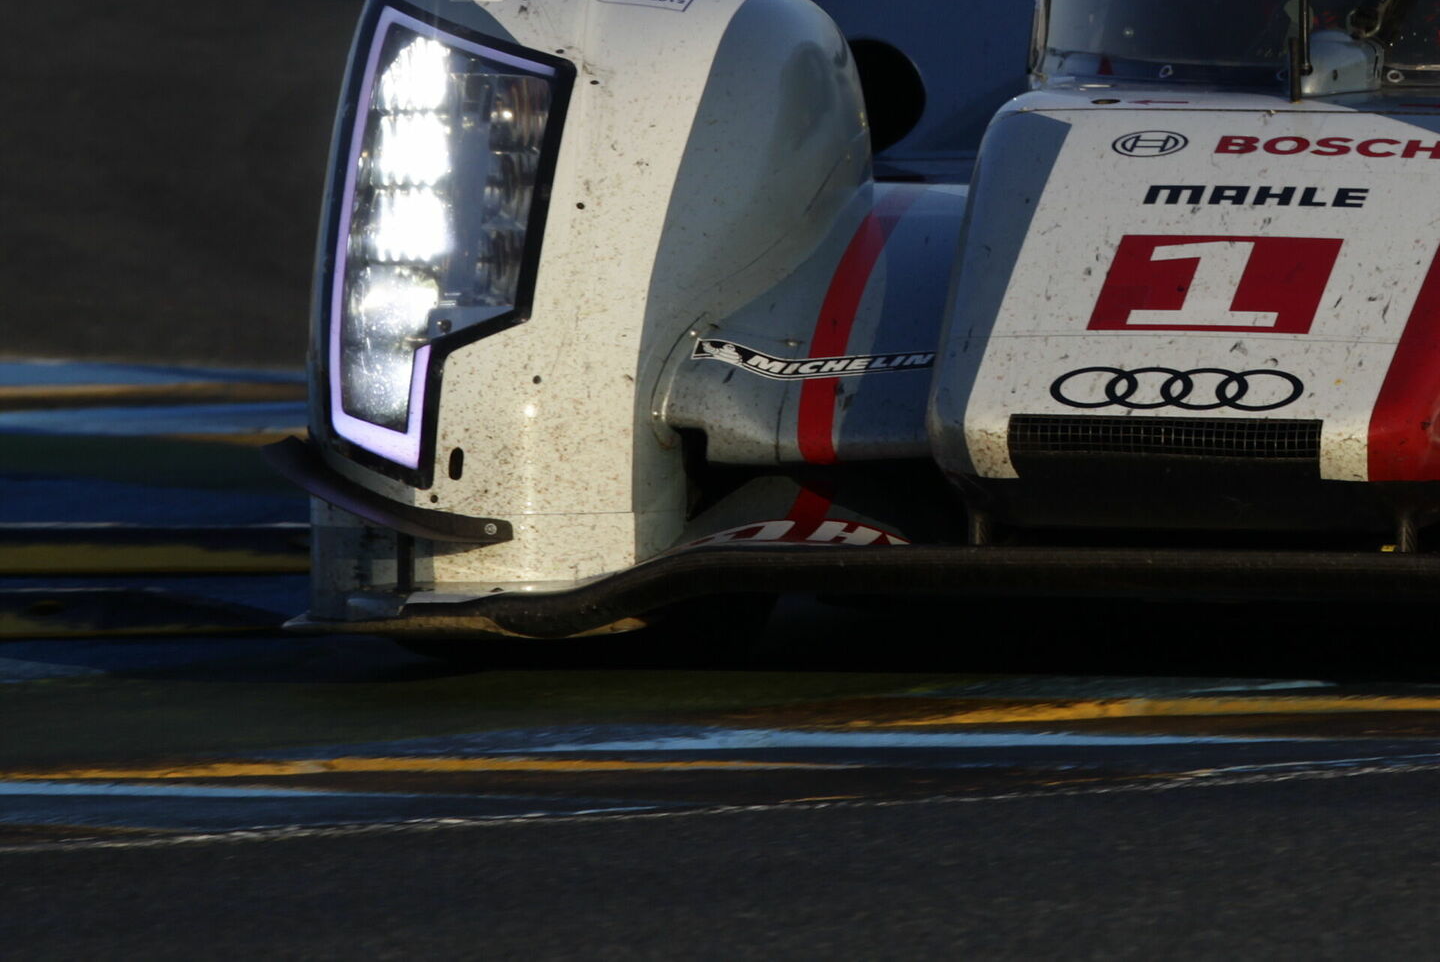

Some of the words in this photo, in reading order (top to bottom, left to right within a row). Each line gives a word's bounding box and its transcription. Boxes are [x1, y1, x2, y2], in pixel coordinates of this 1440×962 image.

[1143, 184, 1370, 208] MAHLE
[1126, 240, 1280, 328] 1
[746, 353, 935, 375] MICHELIN
